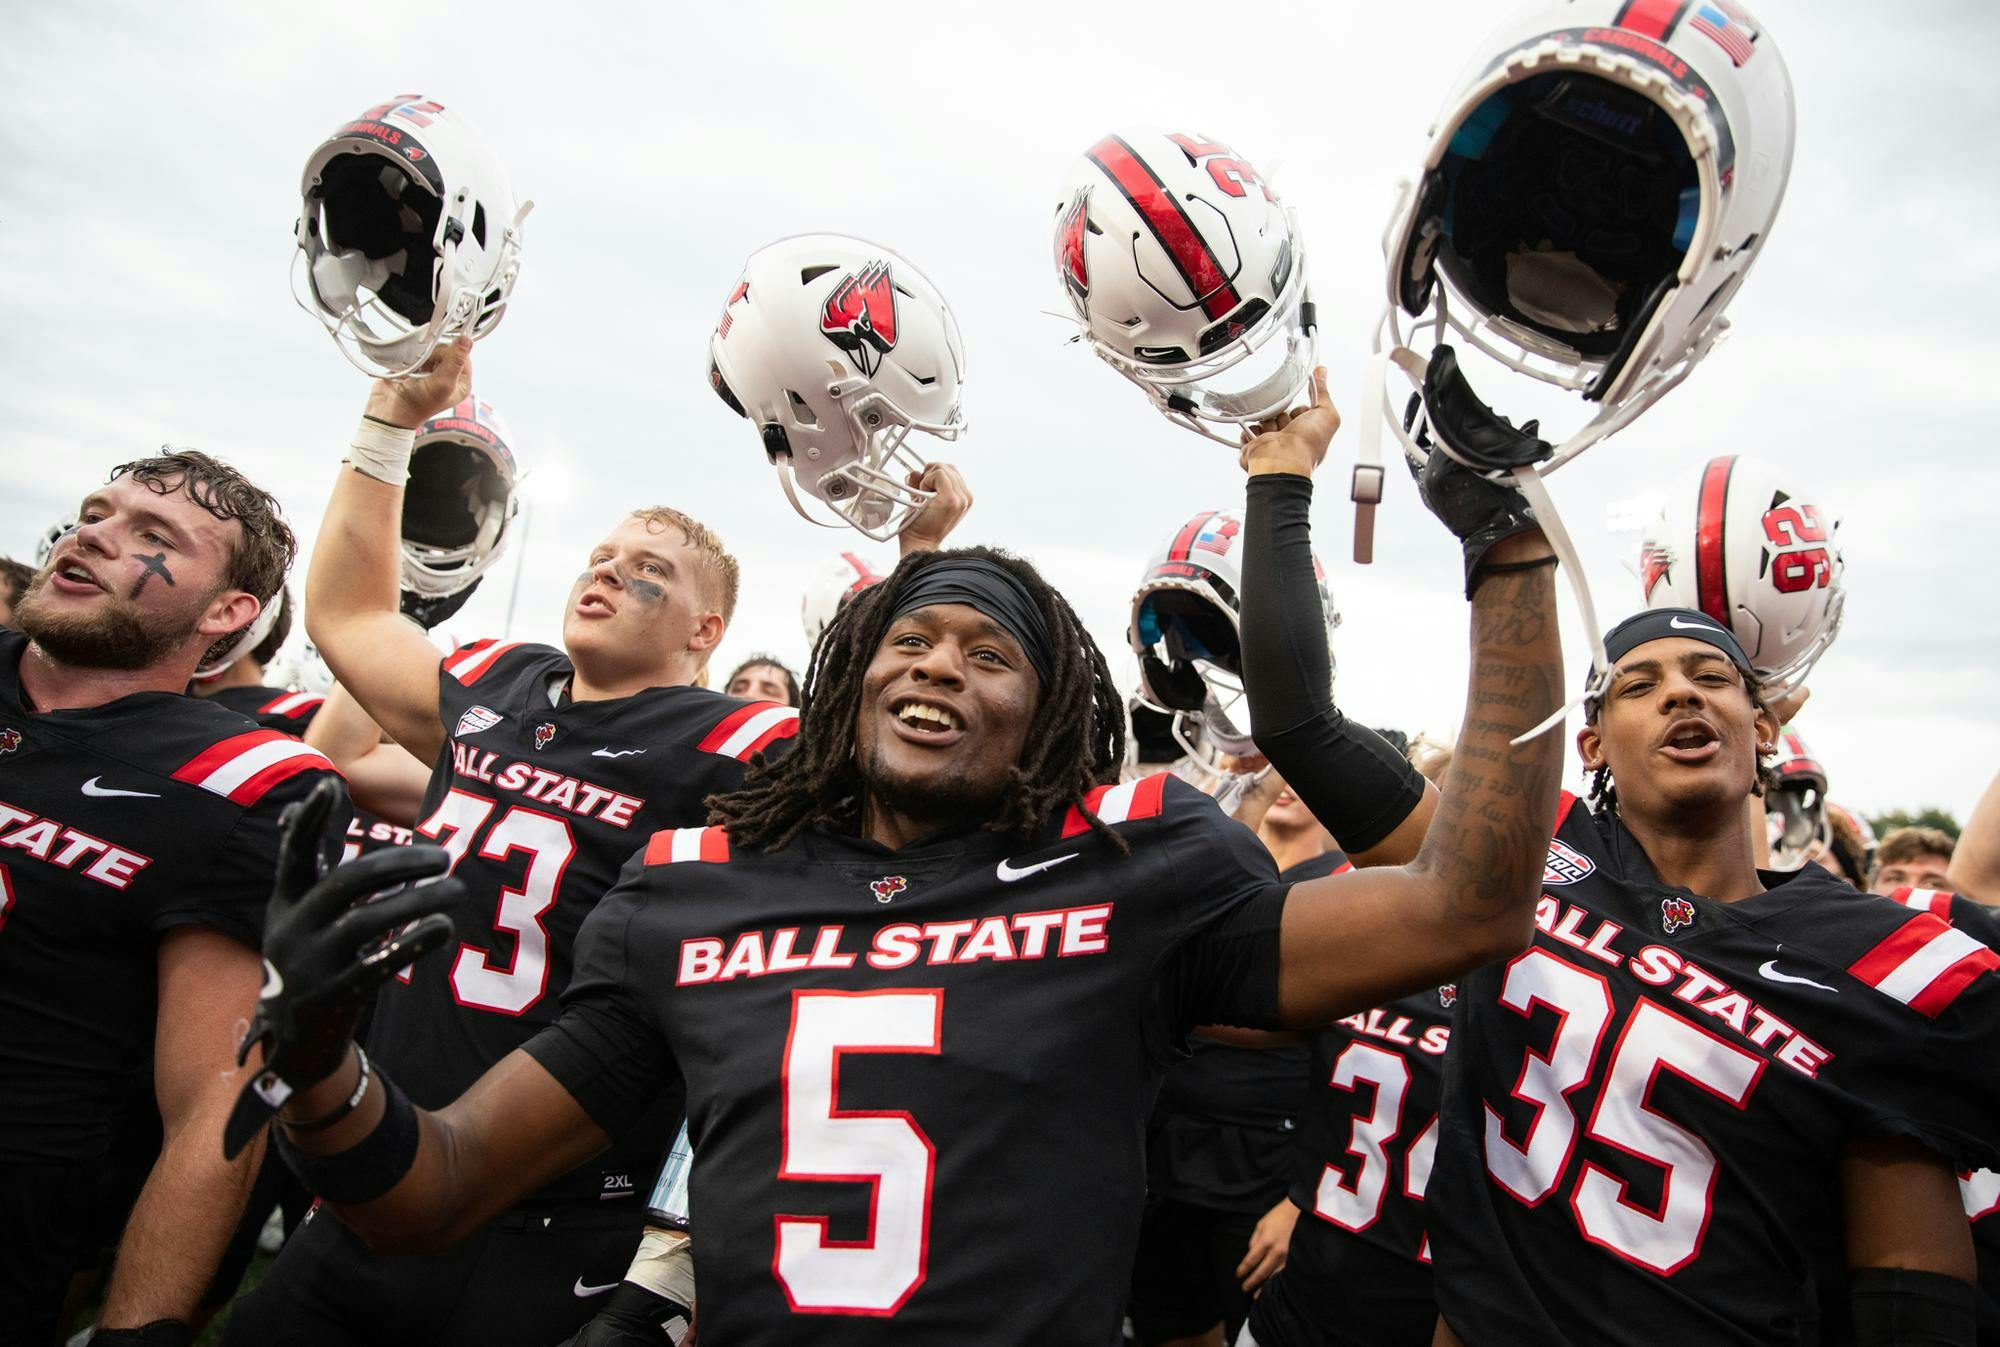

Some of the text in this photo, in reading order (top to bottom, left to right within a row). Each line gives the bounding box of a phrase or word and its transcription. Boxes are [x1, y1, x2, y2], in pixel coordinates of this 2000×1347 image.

[1583, 27, 1688, 79] CARDINALS
[450, 738, 646, 830] ALL STATE
[0, 801, 155, 892] TATE
[394, 787, 578, 1017] 73
[675, 902, 1114, 986] BALL STATE
[1335, 1008, 1416, 1047] ALL
[1535, 893, 1836, 1079] ALL STATE
[771, 987, 945, 1318] 5
[1483, 945, 1770, 1278] 35
[603, 1174, 633, 1189] 2XL
